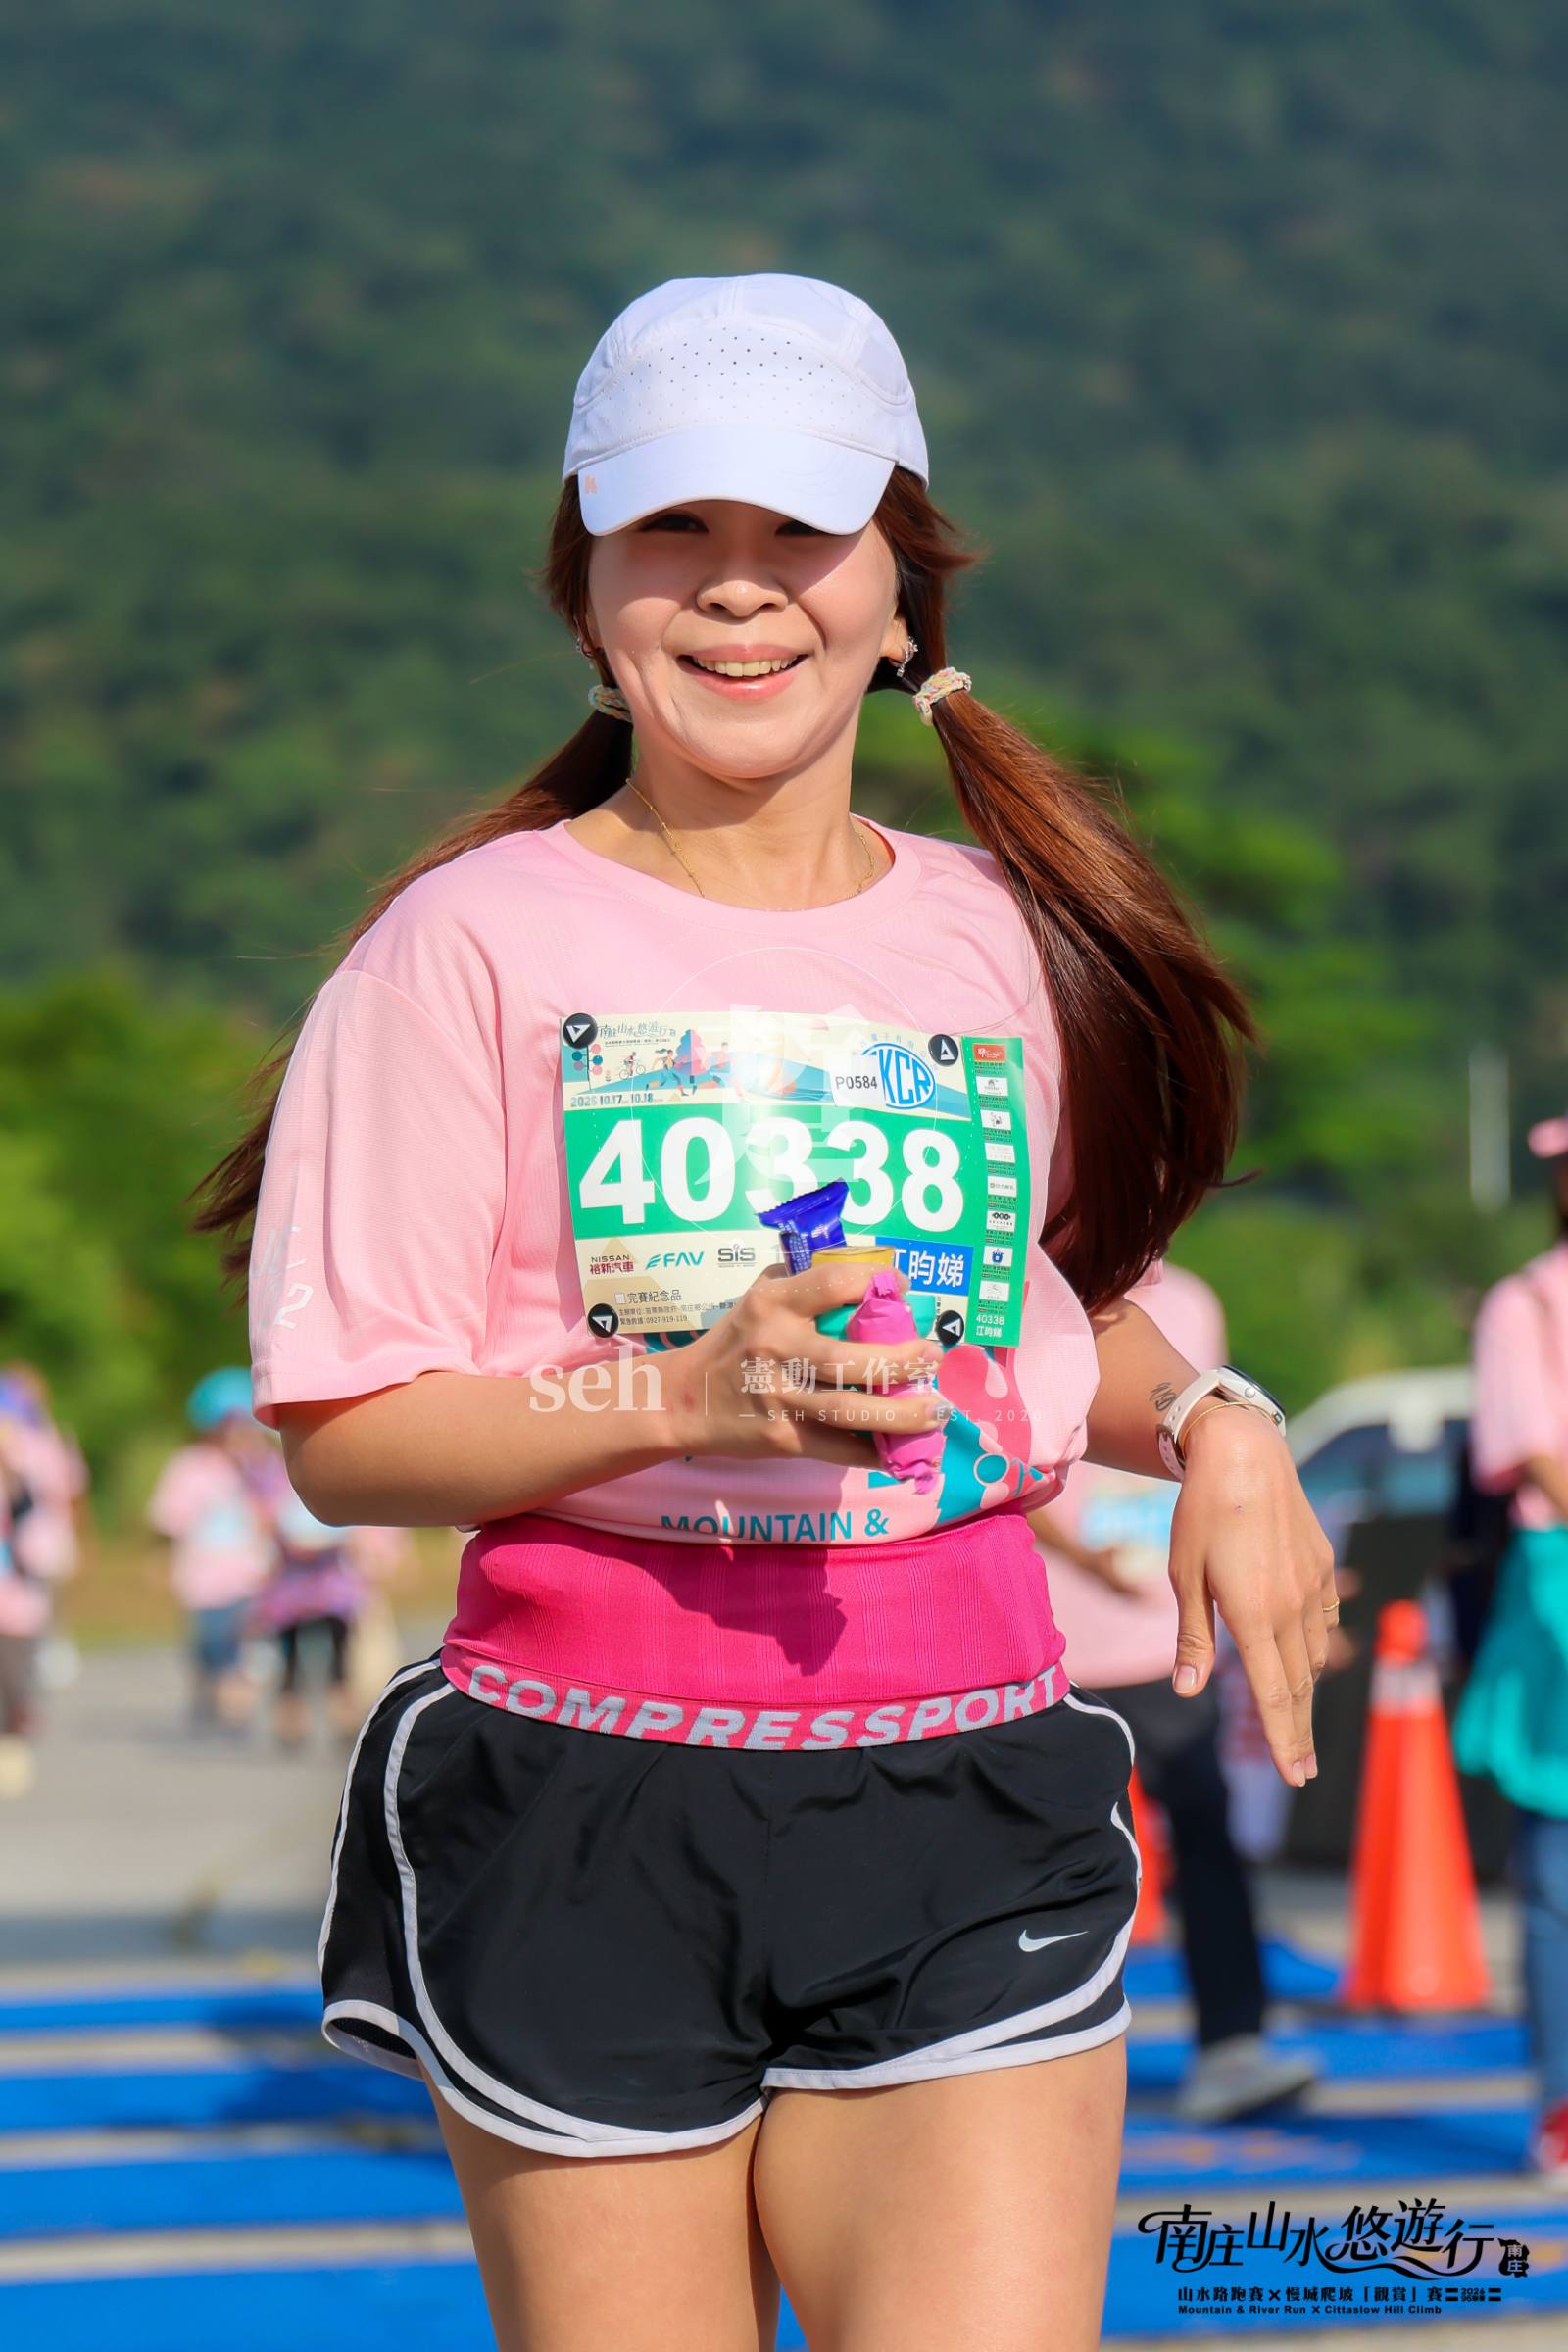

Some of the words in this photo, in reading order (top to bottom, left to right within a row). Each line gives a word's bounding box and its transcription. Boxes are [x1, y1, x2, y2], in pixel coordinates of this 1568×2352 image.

[835, 1075, 878, 1090] P0584
[578, 1116, 963, 1232] 40338
[591, 1254, 630, 1263] NISSAN
[590, 1261, 634, 1275] 裕新汽車
[627, 1289, 682, 1304] 完賽紀念品
[976, 1314, 1004, 1326] 40338
[661, 1511, 852, 1543] MOUNTAIN
[864, 1508, 889, 1538] &
[468, 1664, 1055, 1750] COMPRESSPORT
